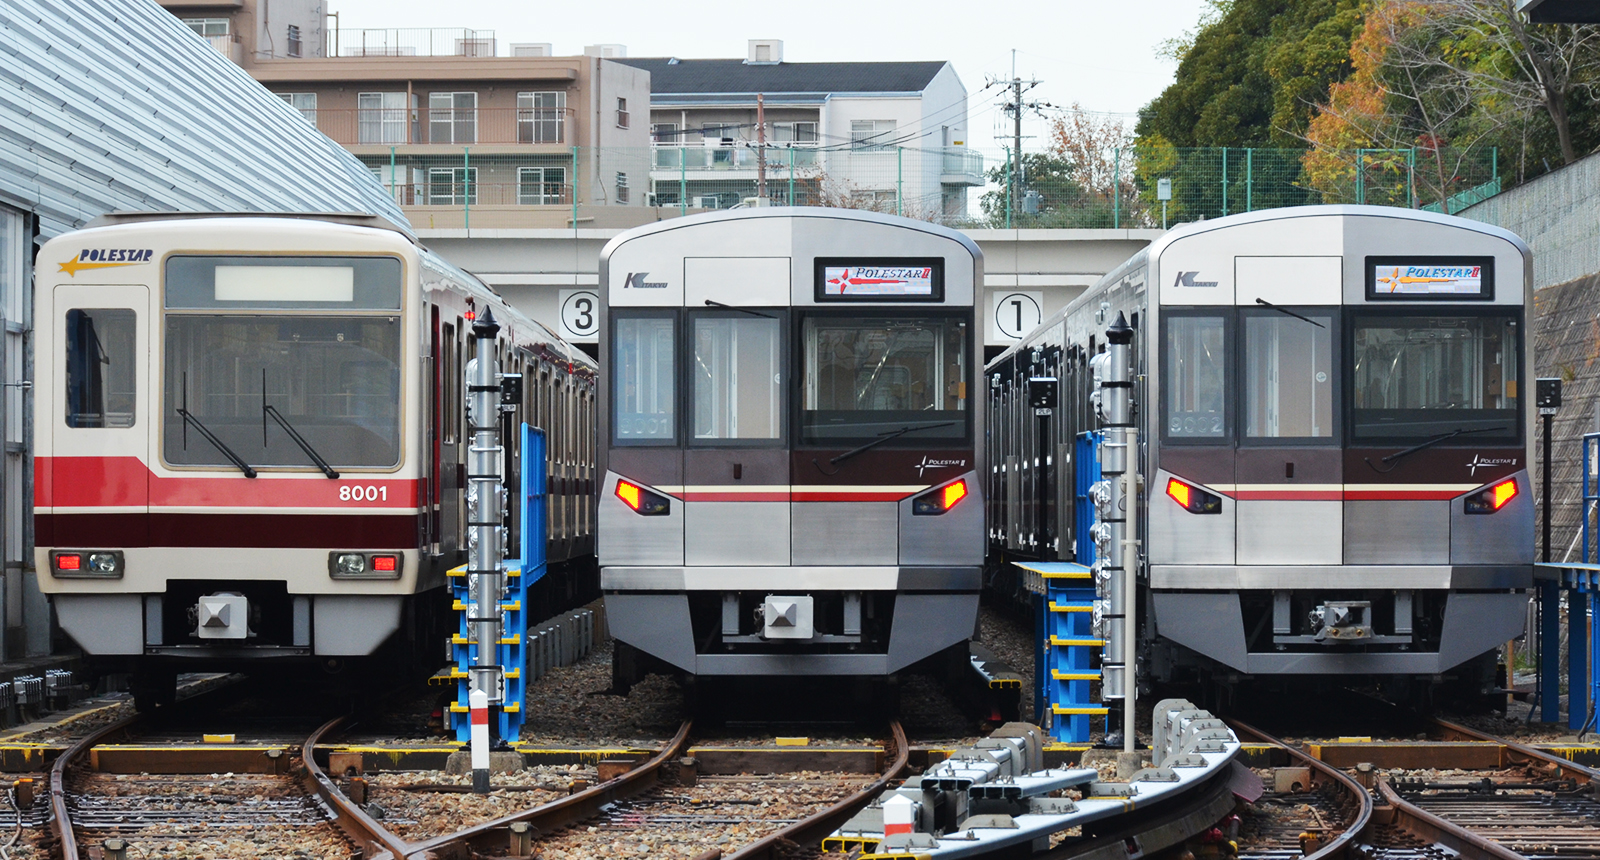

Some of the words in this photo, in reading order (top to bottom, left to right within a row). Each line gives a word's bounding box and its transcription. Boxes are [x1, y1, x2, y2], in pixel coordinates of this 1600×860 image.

[80, 249, 153, 261] POLESTAR
[624, 272, 668, 288] KITAKYU
[1174, 271, 1218, 287] KITAKYU
[575, 298, 593, 330] 3
[1011, 301, 1021, 331] 1
[339, 485, 387, 502] 8001
